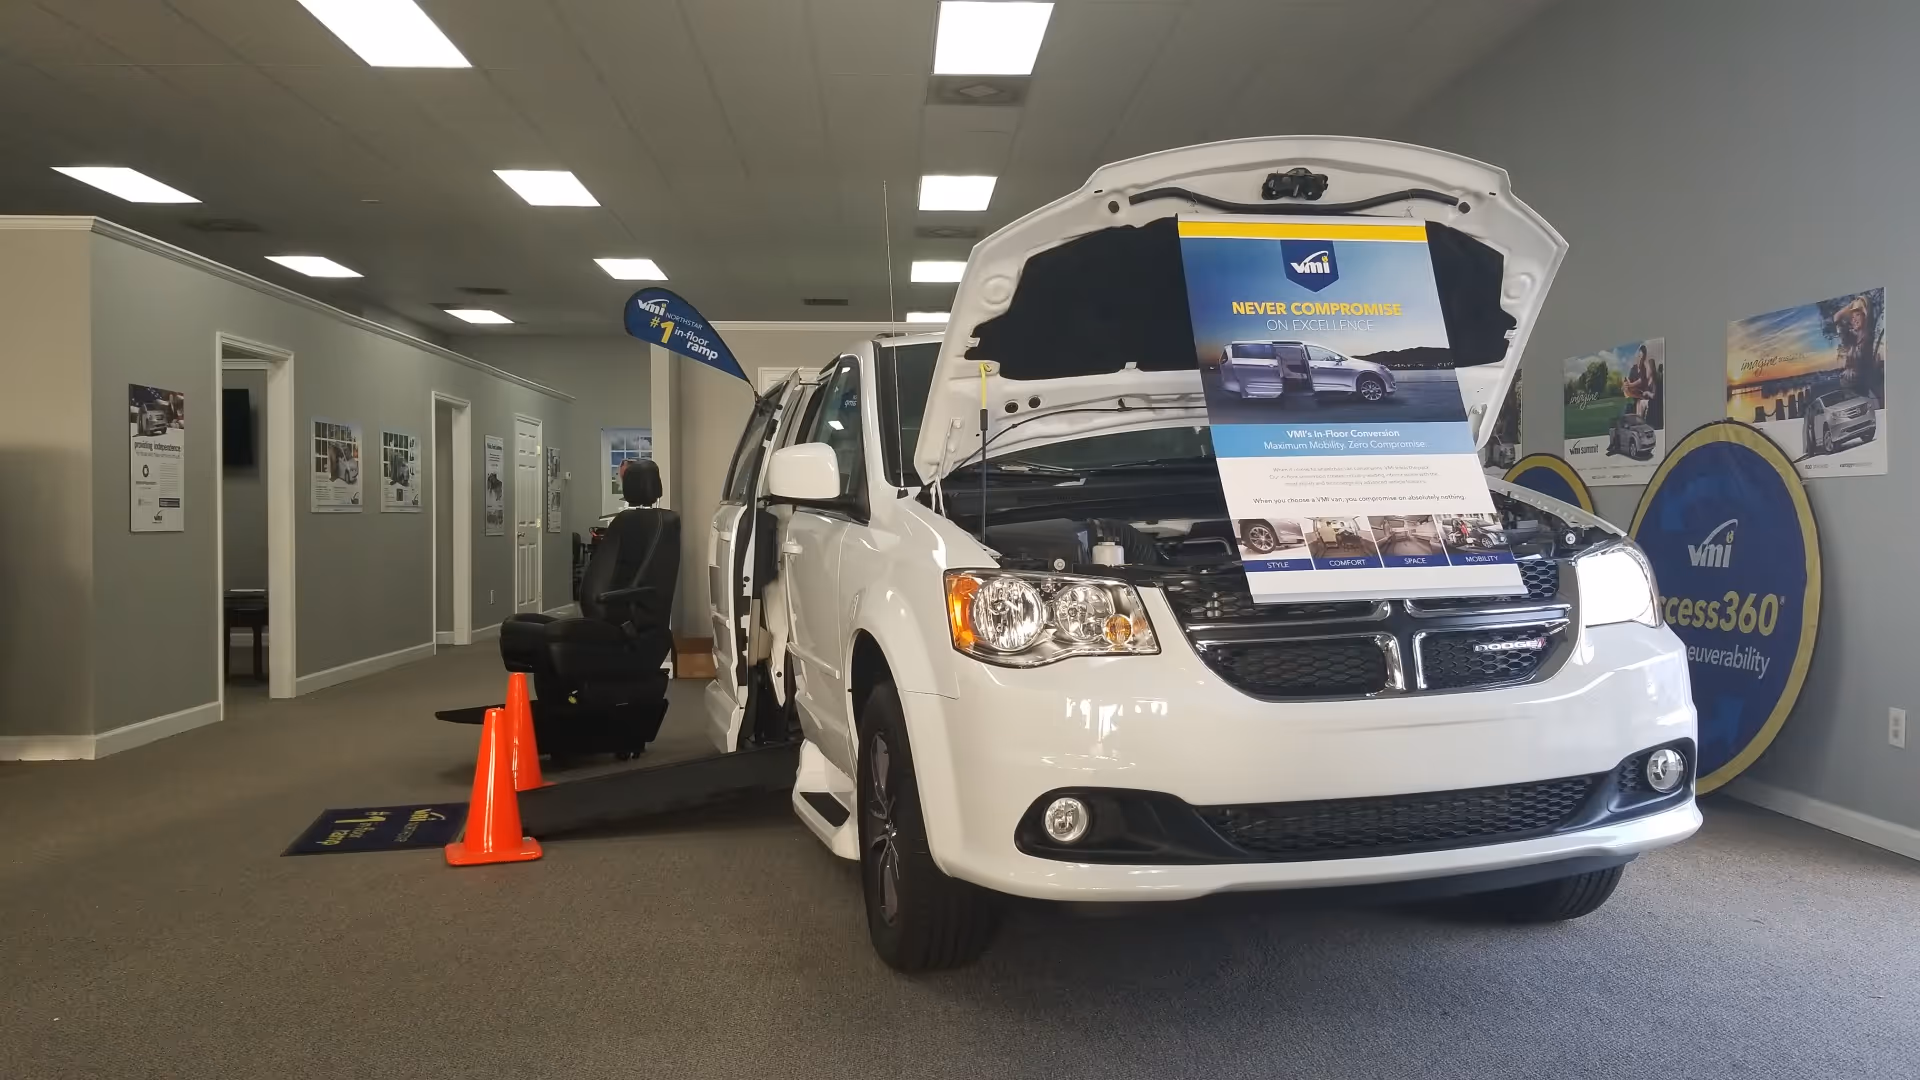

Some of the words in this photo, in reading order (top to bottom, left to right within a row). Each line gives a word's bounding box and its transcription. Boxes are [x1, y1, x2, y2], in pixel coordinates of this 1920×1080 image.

[1290, 250, 1330, 274] vmi
[637, 298, 670, 316] vmi
[665, 312, 704, 330] NORTHSTAR
[1231, 301, 1287, 315] NEVER
[1291, 302, 1403, 316] COMPROMISE
[1266, 319, 1289, 332] ON
[1292, 319, 1376, 332] EXCELLENCE
[674, 326, 710, 347] in-floor
[686, 340, 719, 361] ramp
[1740, 355, 1778, 377] imagine
[1286, 430, 1312, 439] VMI's
[1314, 429, 1349, 438] In-Floor
[1350, 428, 1401, 438] Conversion
[1263, 441, 1308, 450] Maximum
[1348, 440, 1369, 449] Zero
[1407, 494, 1440, 502] absolutely
[1687, 518, 1739, 568] vmi
[1266, 561, 1289, 569] STYLE
[1329, 558, 1366, 567] COMFORT
[1474, 639, 1541, 653] DODGE
[1687, 644, 1771, 680] euverability
